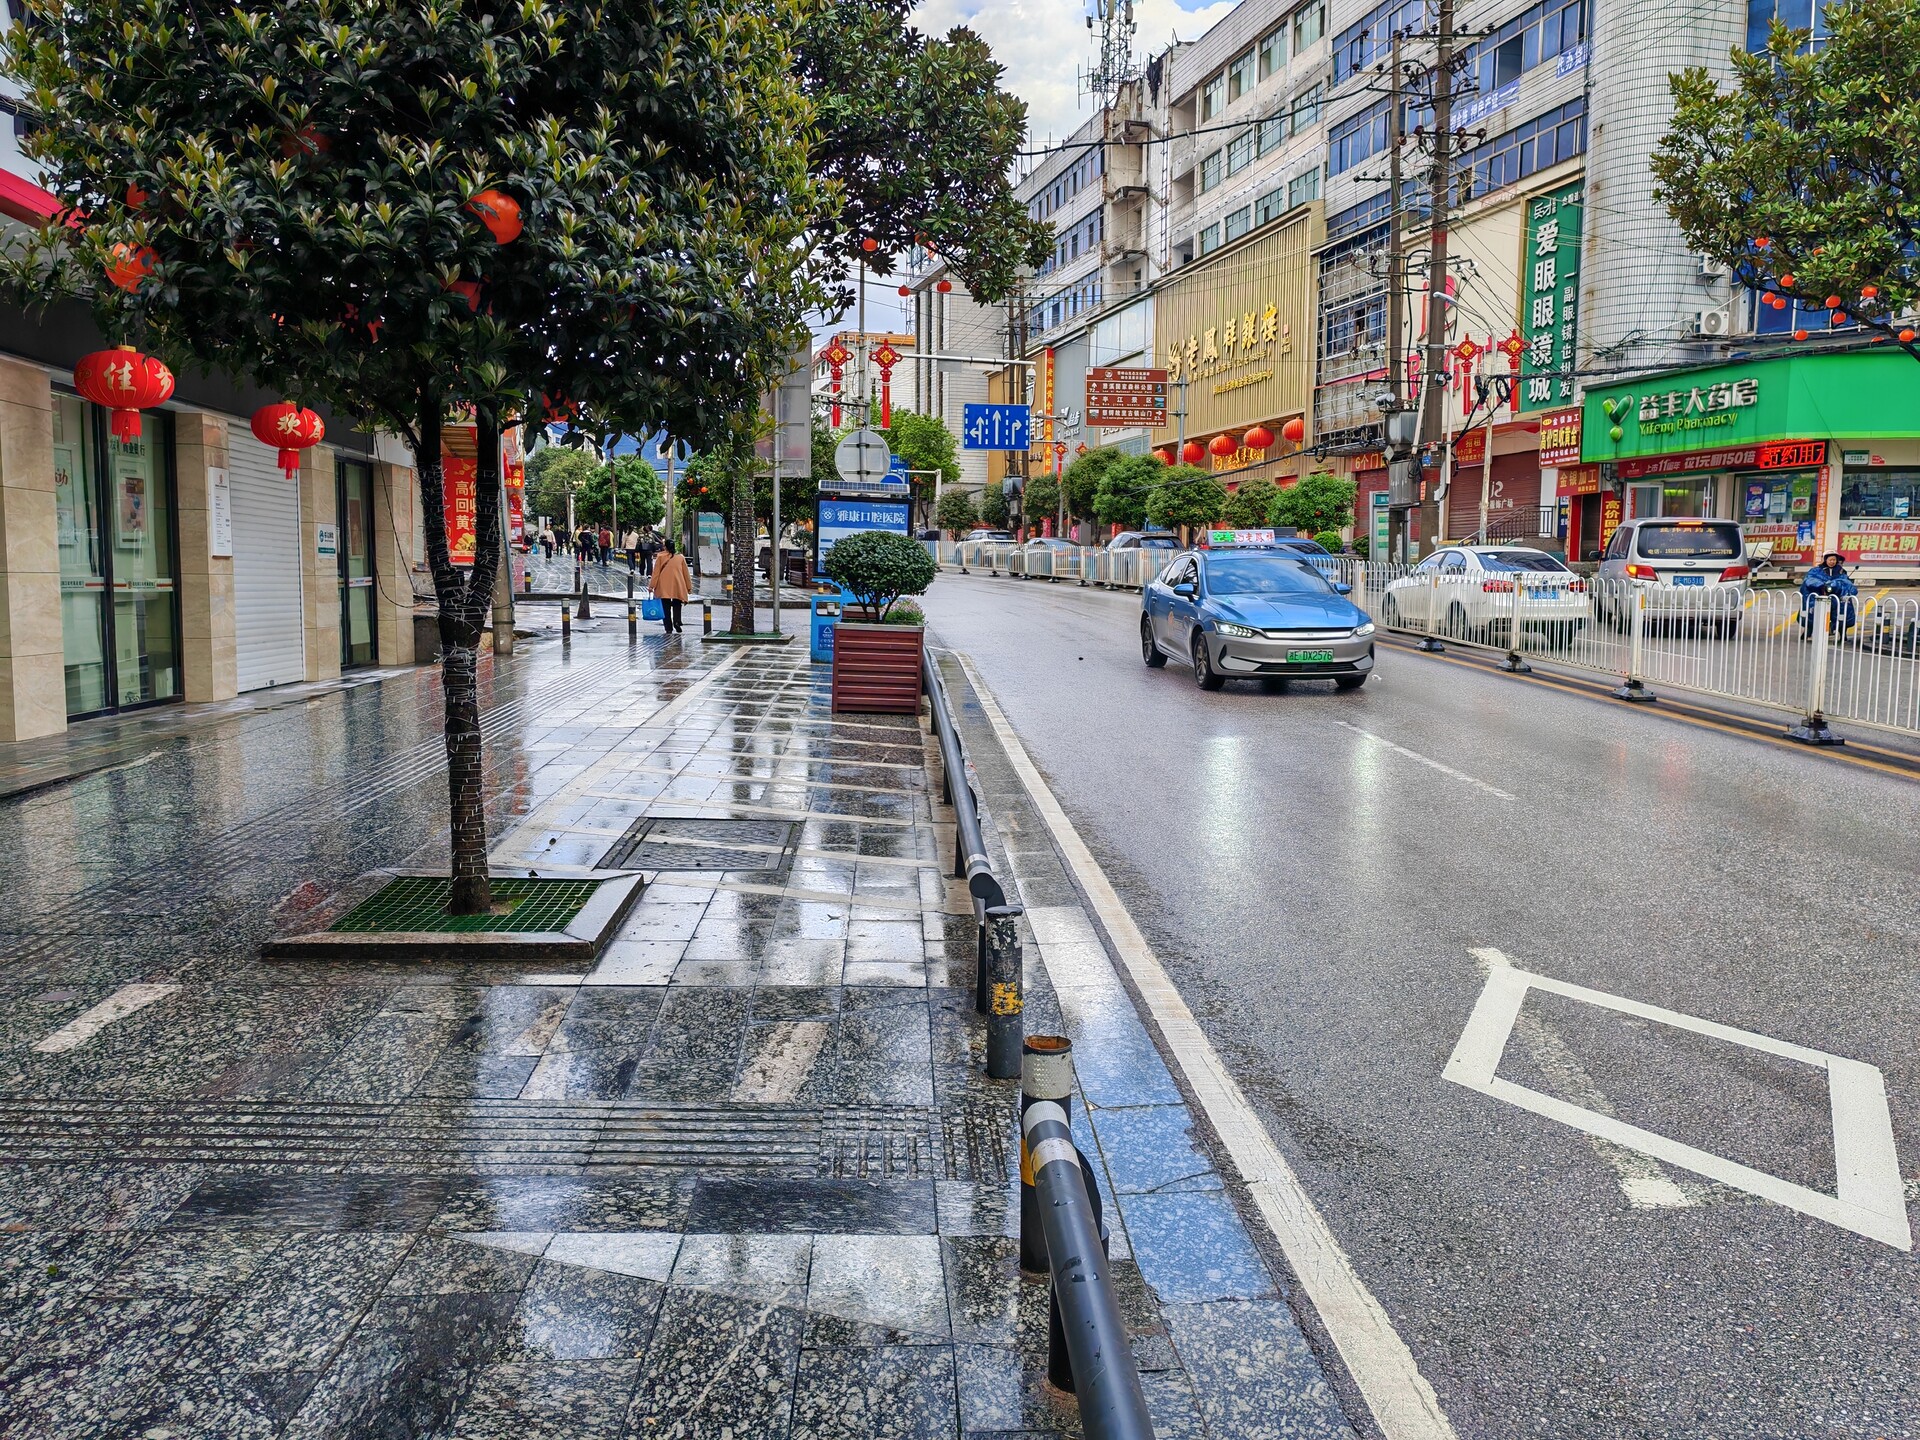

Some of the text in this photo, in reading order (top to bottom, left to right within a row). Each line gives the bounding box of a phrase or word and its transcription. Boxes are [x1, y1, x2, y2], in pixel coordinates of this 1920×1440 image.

[1528, 218, 1558, 402] 爱眼眼镜城
[1639, 378, 1759, 421] 益丰大药房
[1639, 413, 1738, 436] Yifeng Pharmacy
[1684, 450, 1756, 470] 花1元翻150倍
[1559, 469, 1597, 488] 金银加工
[837, 510, 905, 524] 雅康口腔医院
[1213, 531, 1235, 543] 空车
